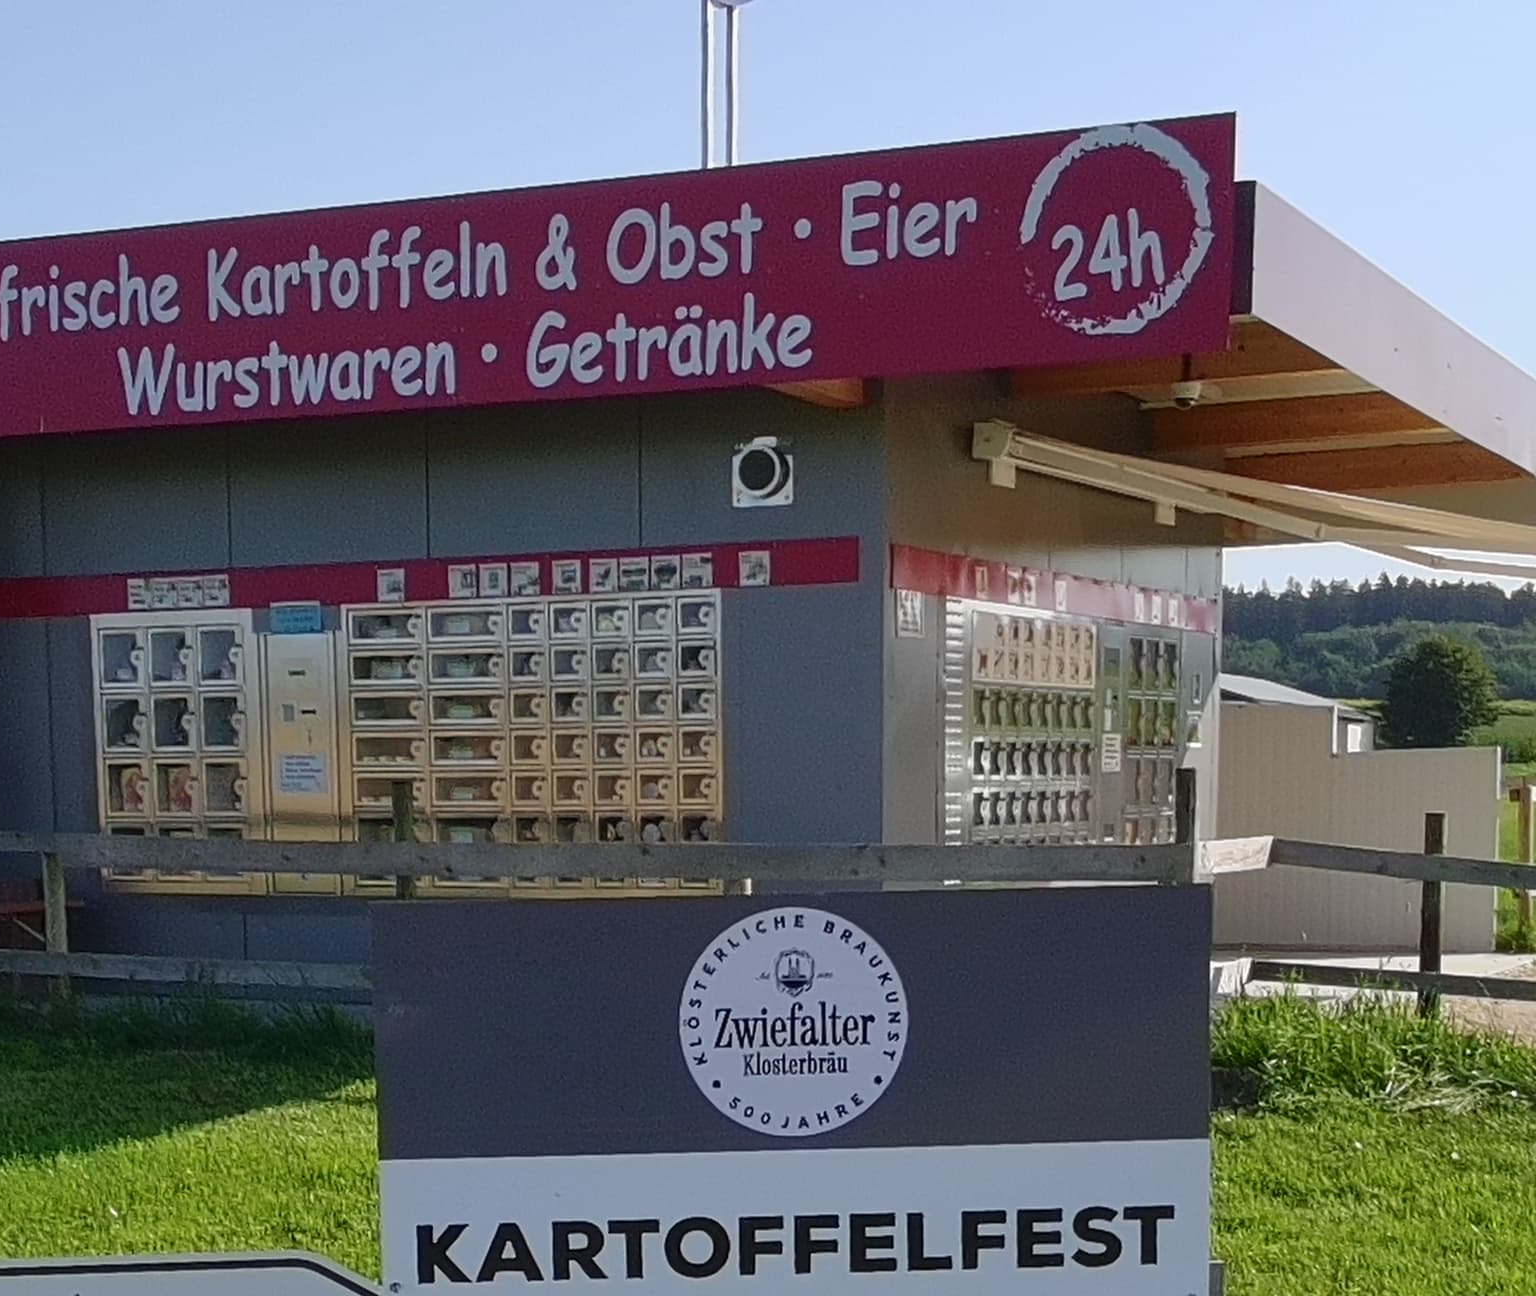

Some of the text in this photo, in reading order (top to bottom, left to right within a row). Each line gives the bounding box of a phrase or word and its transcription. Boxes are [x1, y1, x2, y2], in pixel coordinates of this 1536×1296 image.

[206, 220, 507, 322] Kartoffeln
[534, 212, 578, 291] &
[605, 202, 764, 280] Obst
[839, 180, 978, 268] Eier
[1051, 207, 1166, 302] 24h
[116, 340, 457, 417] Wurstwaren
[525, 293, 814, 388] Getränke
[683, 914, 805, 1066] KLÖSTERLICHE
[713, 1001, 876, 1050] Zwiefalter
[822, 920, 902, 1062] BRAUKUNST
[743, 1051, 848, 1077] Klosterbräu
[415, 1204, 1176, 1285] KARTOFFELFEST
